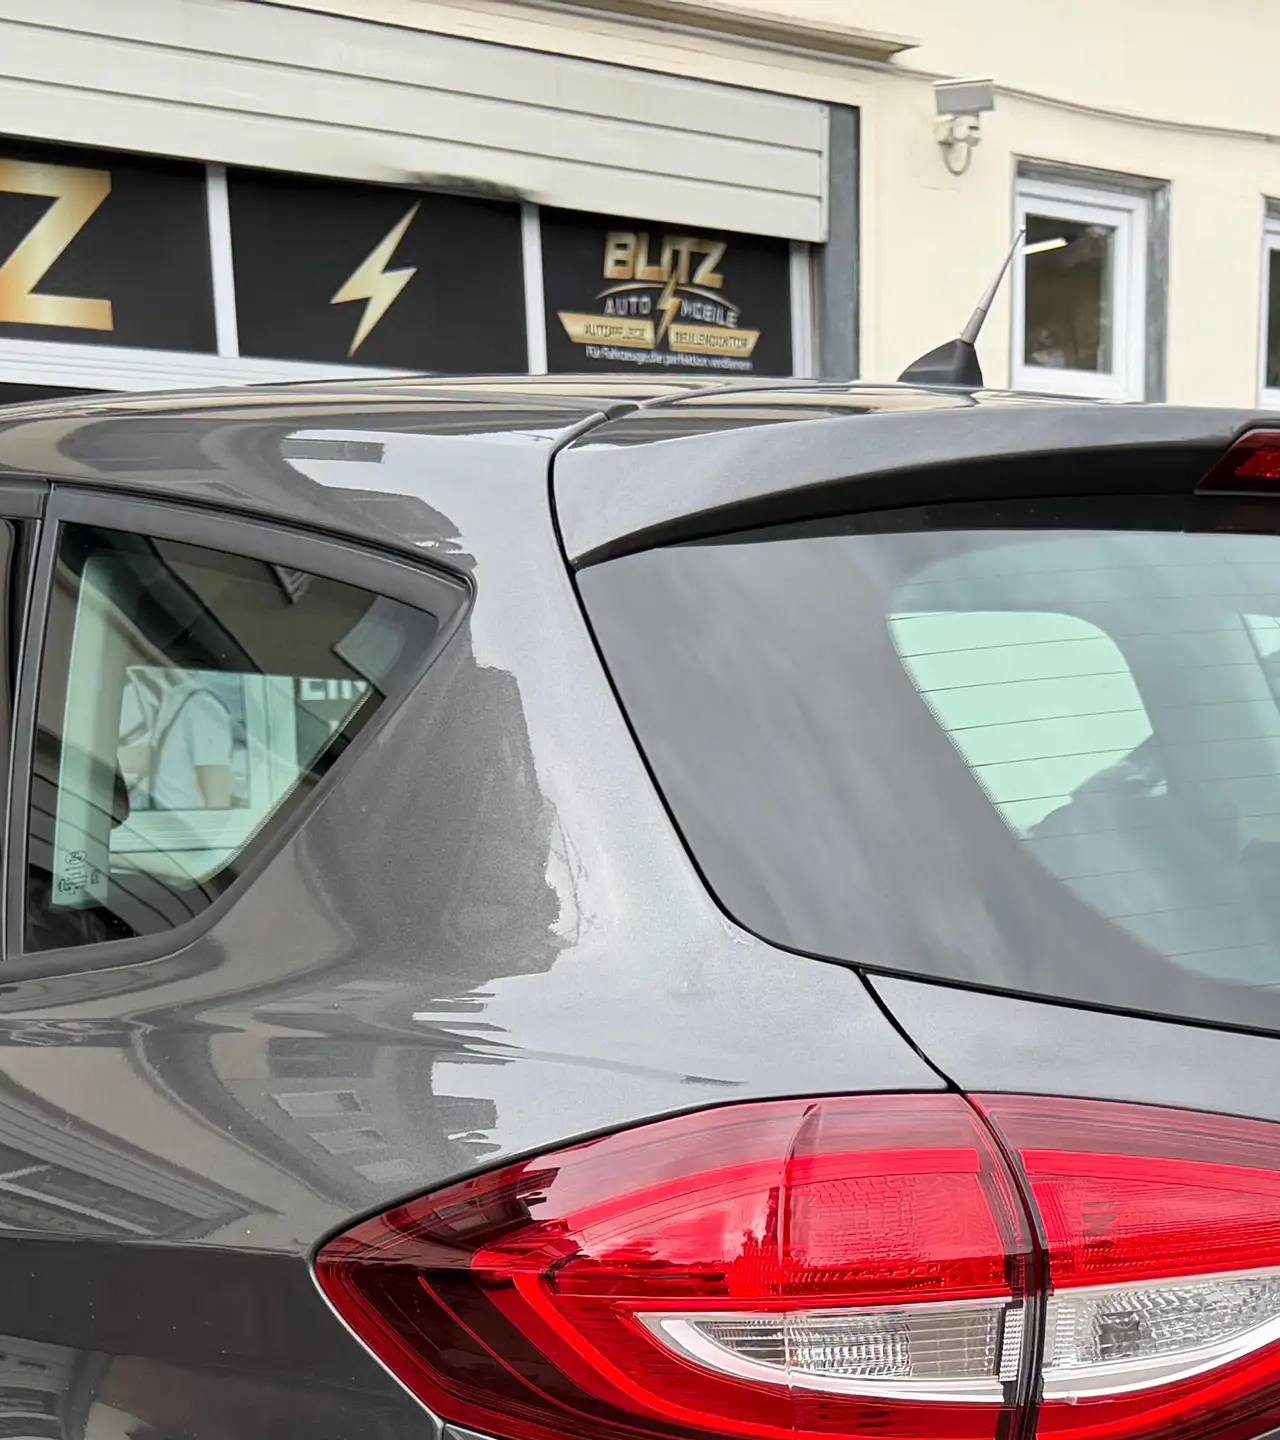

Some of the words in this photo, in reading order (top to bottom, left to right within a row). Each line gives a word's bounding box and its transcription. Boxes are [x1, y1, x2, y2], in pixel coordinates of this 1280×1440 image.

[603, 231, 728, 289] BLITZ
[603, 296, 652, 316] AUTO
[681, 299, 738, 328] MOBILE
